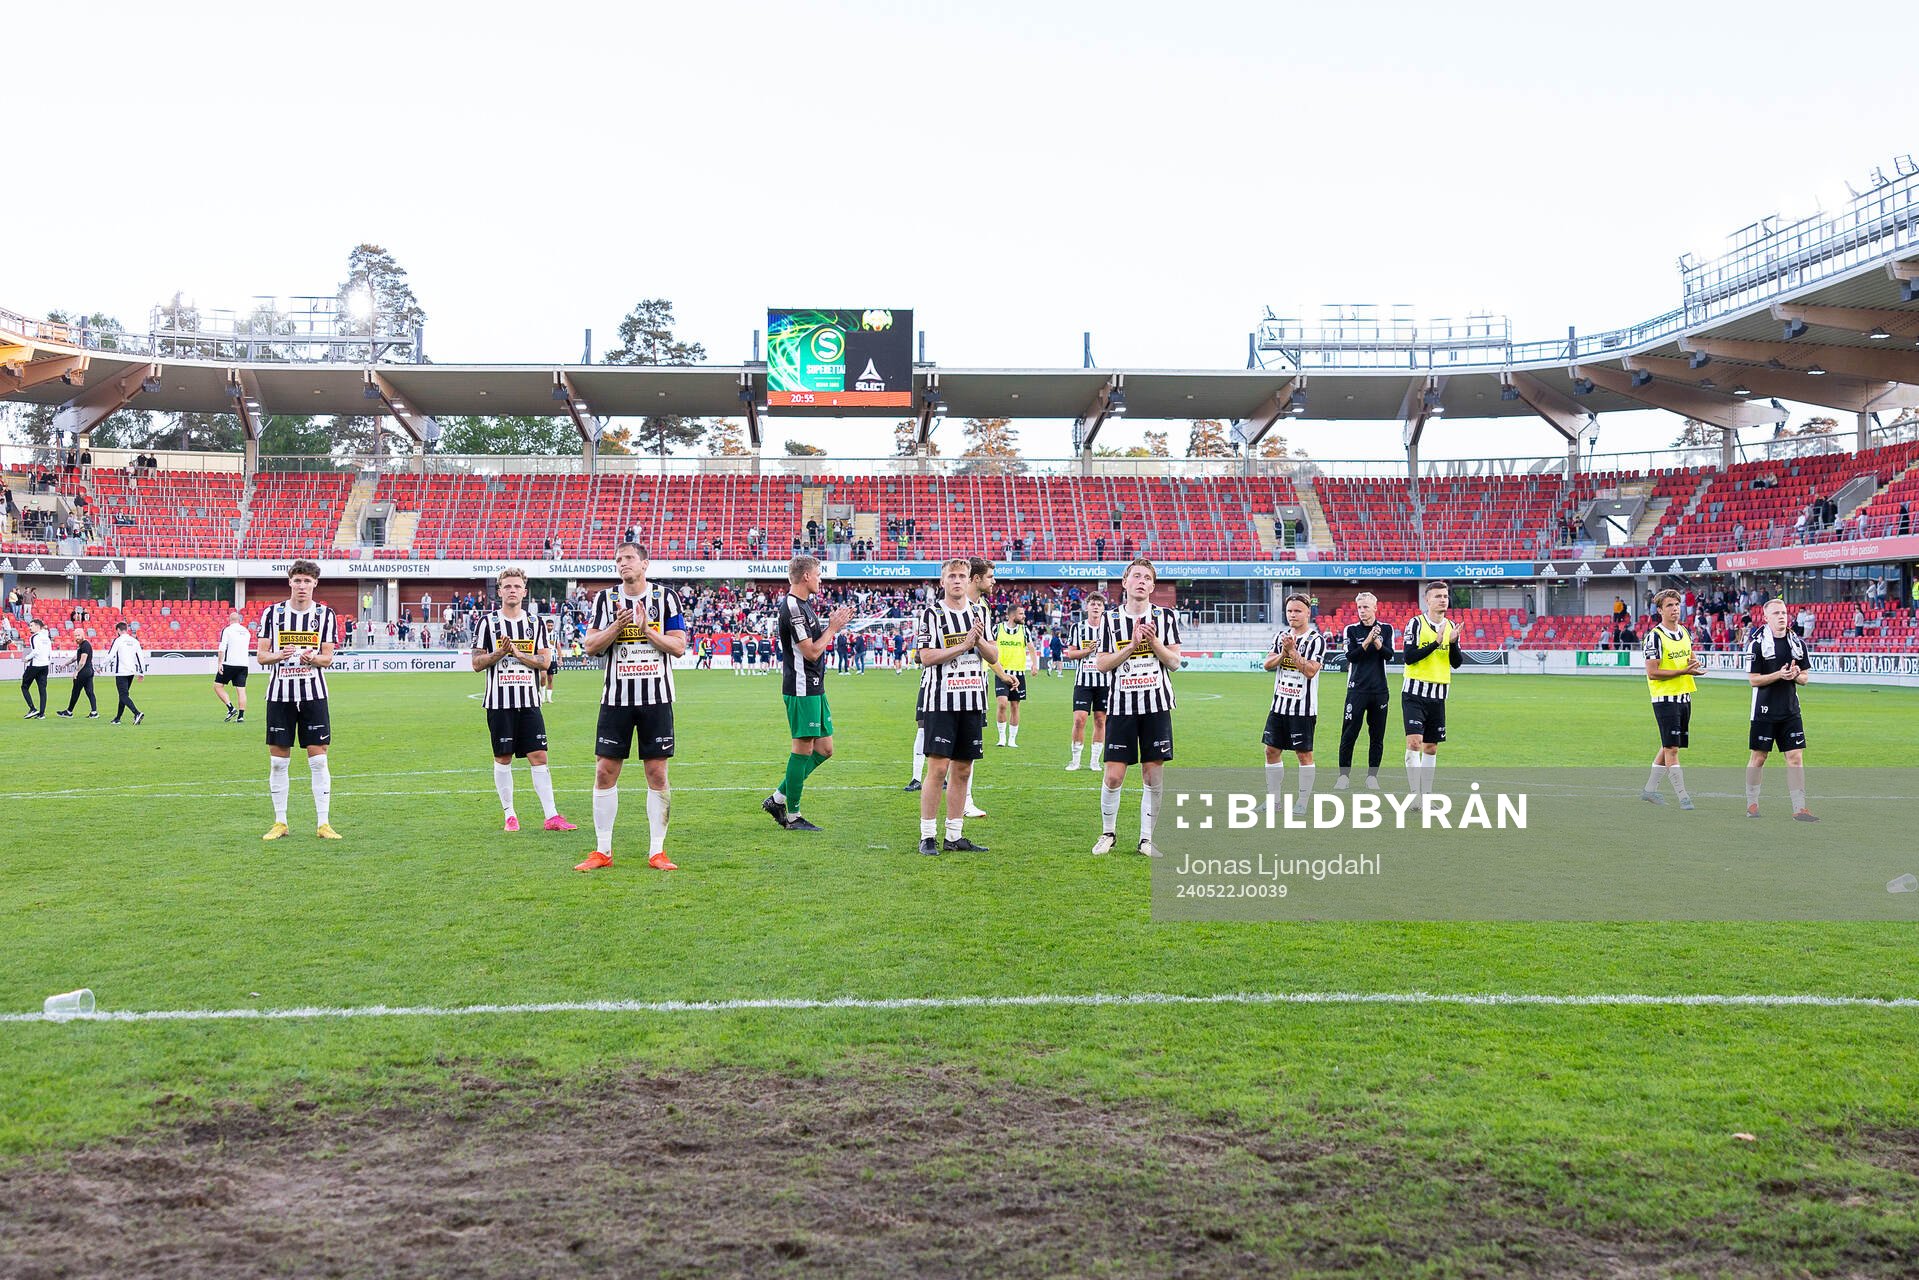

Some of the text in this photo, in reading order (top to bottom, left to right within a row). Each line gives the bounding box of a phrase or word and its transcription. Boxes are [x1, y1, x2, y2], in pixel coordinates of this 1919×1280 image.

[855, 382, 885, 391] SELECT
[791, 394, 814, 402] 20:55
[1859, 545, 1878, 557] passion
[139, 562, 225, 572] SMÅLANDSPOSTEN
[348, 563, 430, 572] SMÅLANDSPOSTEN
[549, 563, 617, 572] SMÅLANDSPOST
[672, 565, 705, 574] smp.se
[873, 564, 910, 576] bravida
[1069, 566, 1106, 576] bravida
[1165, 566, 1209, 576] fastigheter
[1211, 566, 1221, 574] liv.
[1264, 566, 1301, 576] bravida
[1333, 566, 1415, 576] Vi ger fastigheter liv.
[1465, 565, 1504, 576] bravida
[354, 658, 366, 670] är
[368, 659, 380, 669] IT
[383, 661, 407, 669] som
[411, 658, 456, 669] förenar
[619, 664, 658, 672] FLYTGOLV
[1843, 657, 1856, 672] DE
[1122, 676, 1157, 685] FLYTGOLV
[1761, 705, 1768, 713] 19
